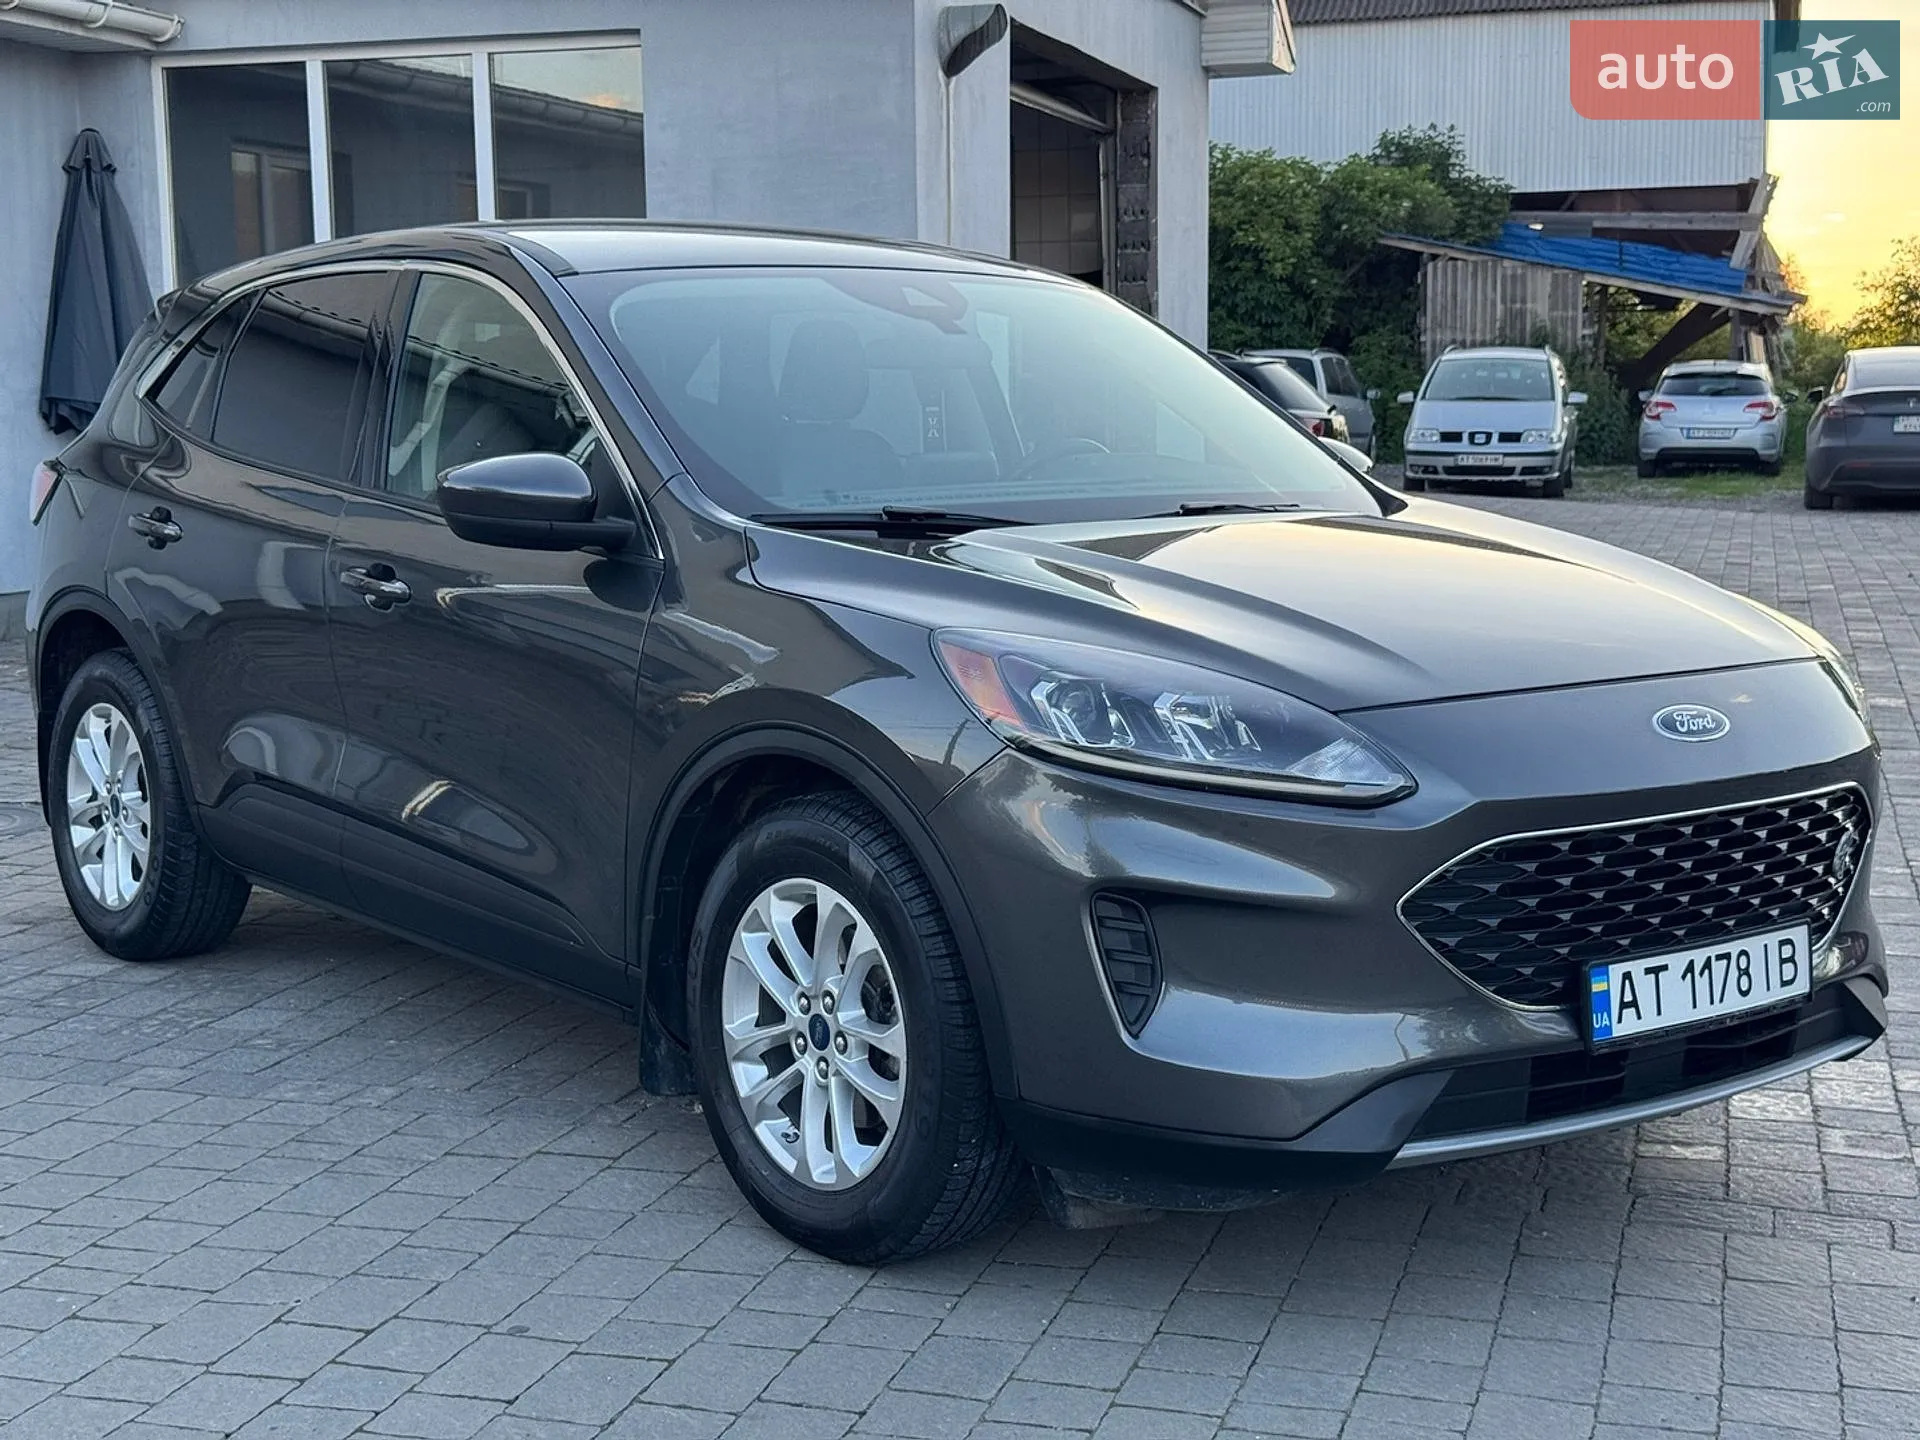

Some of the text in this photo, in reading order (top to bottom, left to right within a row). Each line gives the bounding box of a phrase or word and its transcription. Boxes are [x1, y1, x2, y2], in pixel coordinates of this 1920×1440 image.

[1672, 710, 1716, 732] Ford
[1616, 937, 1799, 1024] AT 1178 IB
[1592, 1012, 1610, 1029] UA
